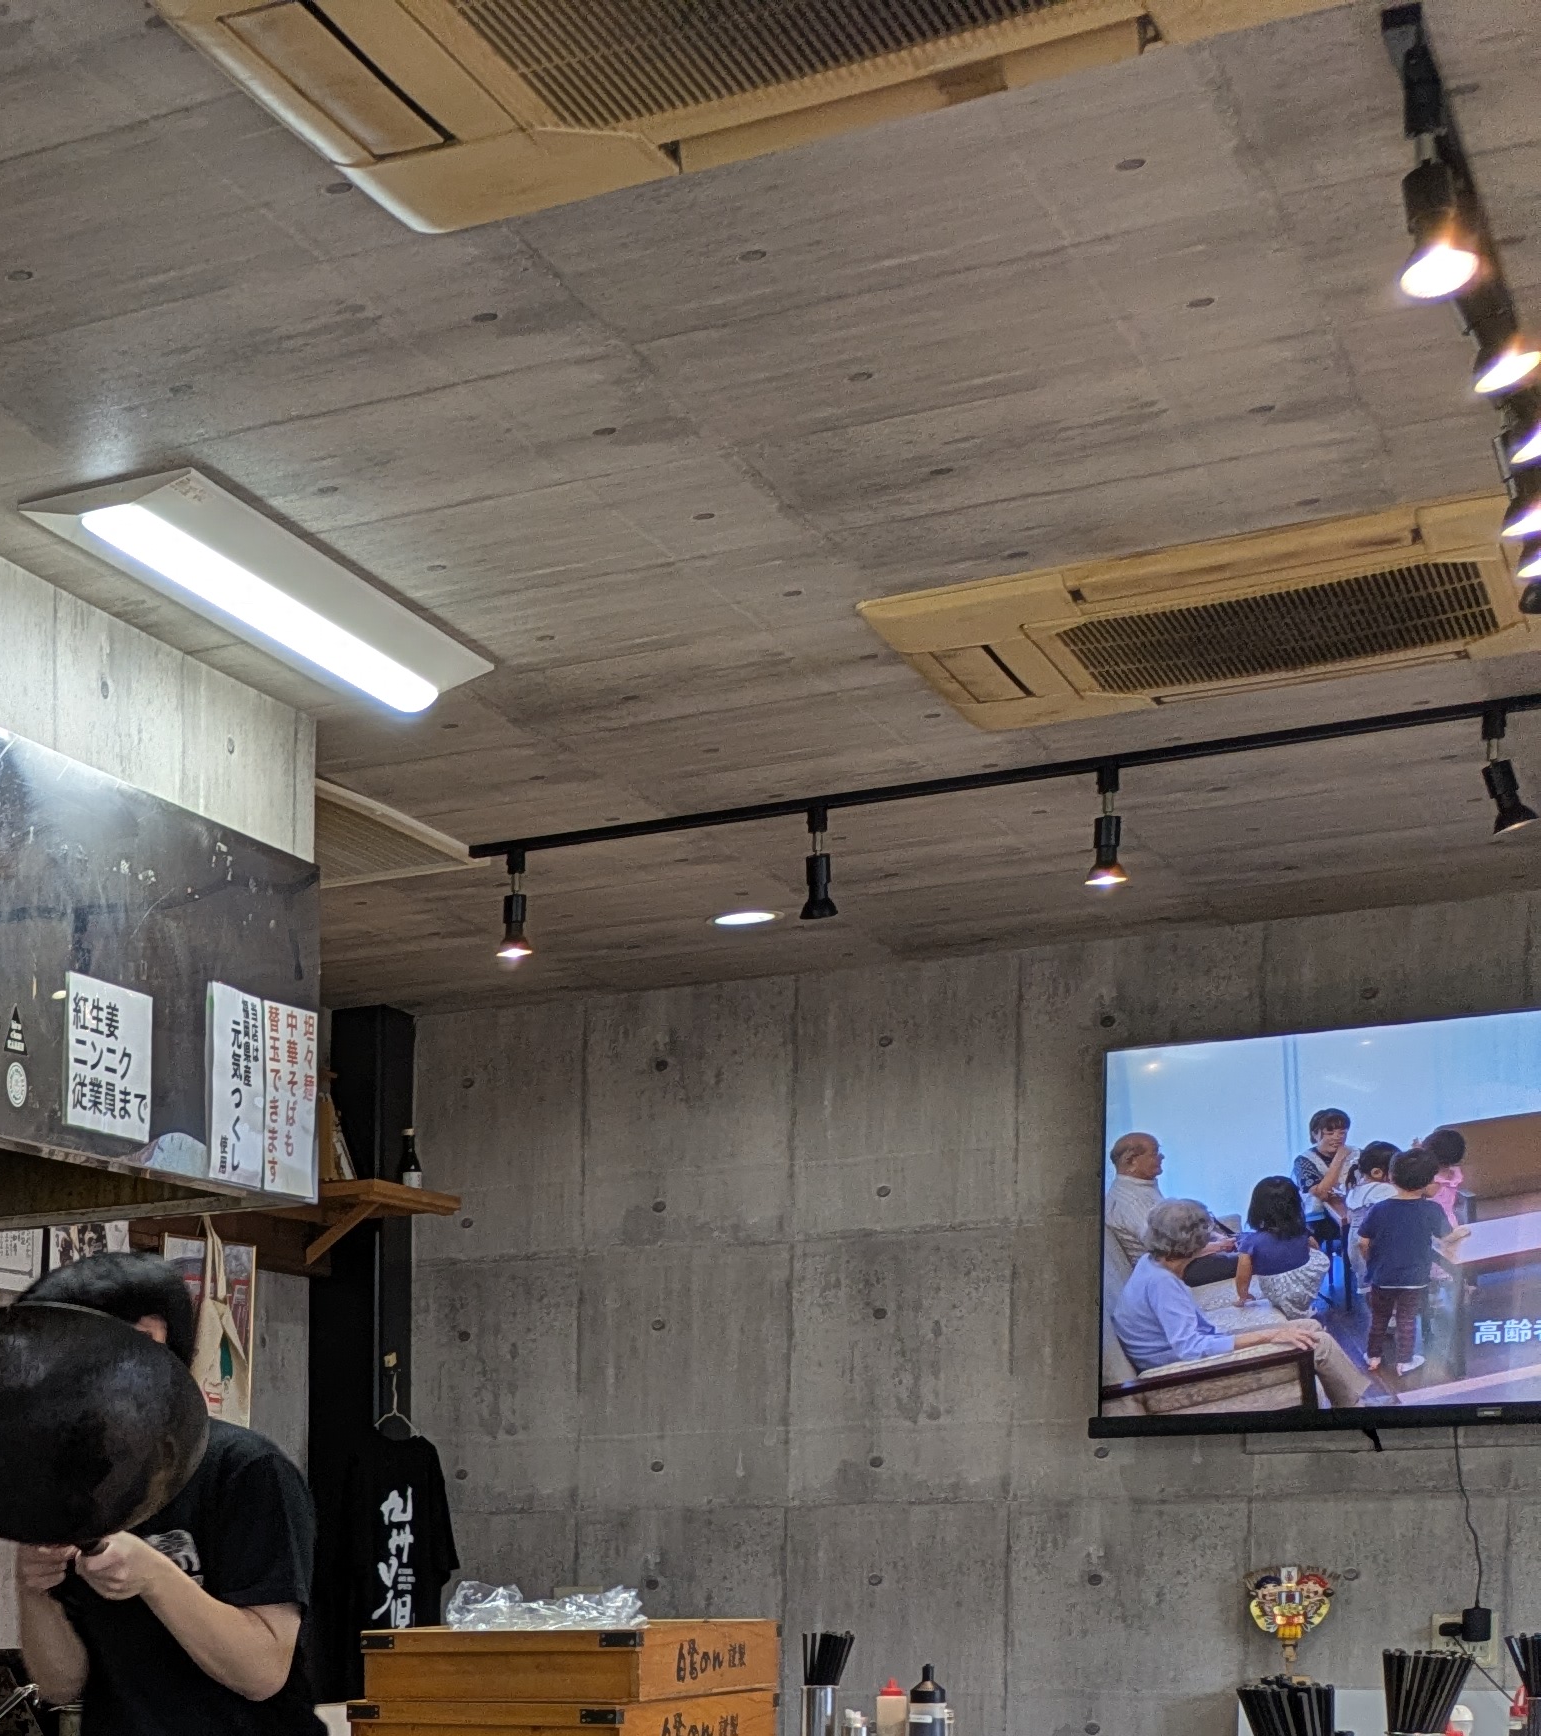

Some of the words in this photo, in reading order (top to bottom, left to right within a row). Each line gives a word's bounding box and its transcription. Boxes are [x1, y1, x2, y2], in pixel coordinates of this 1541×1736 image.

[72, 991, 120, 1041] 紅生姜
[73, 1037, 133, 1080] ニンニク
[285, 1010, 298, 1158] 中華そばも
[72, 1072, 149, 1124] 従業員まで
[231, 1019, 243, 1172] 元気つくし
[267, 1005, 281, 1184] 替玉できます
[1473, 1318, 1541, 1345] 高齢
